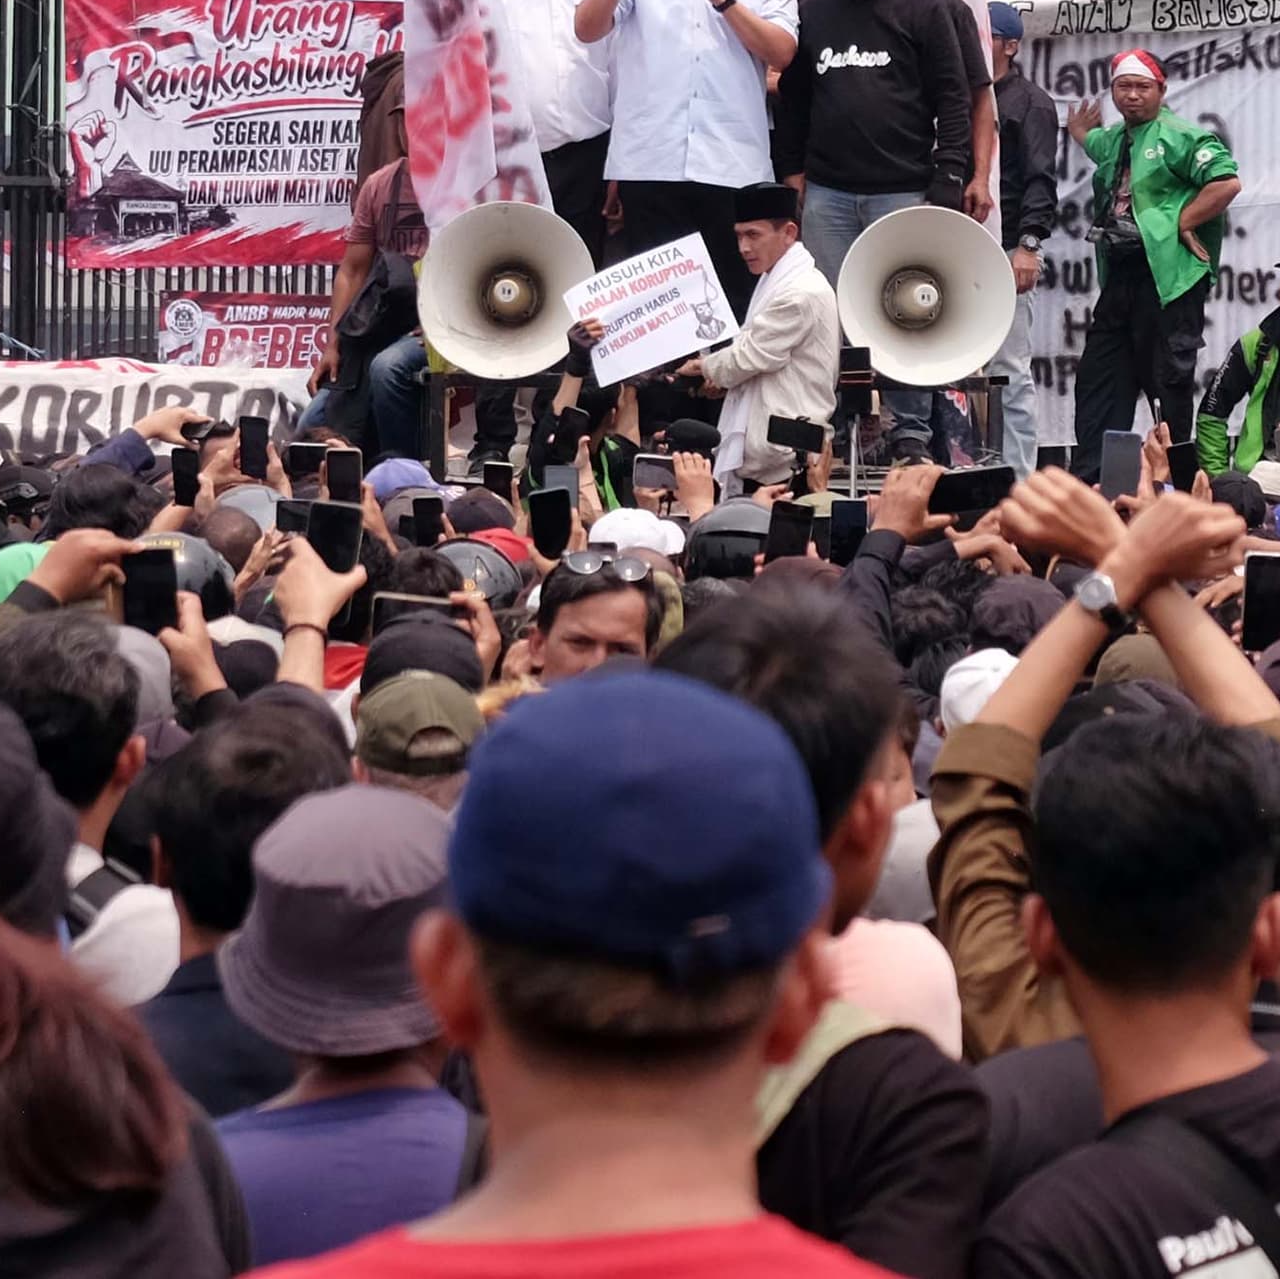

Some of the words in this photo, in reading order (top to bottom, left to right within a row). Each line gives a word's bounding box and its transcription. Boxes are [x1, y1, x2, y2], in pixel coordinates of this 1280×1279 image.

[816, 45, 892, 76] Jackson
[213, 120, 280, 146] SEGERA
[288, 120, 322, 145] SAH
[149, 150, 170, 173] UU
[177, 149, 295, 174] PERAMPASAN
[298, 149, 341, 172] ASET
[187, 179, 218, 205] DAN
[223, 179, 279, 205] HUKUM
[284, 178, 320, 204] MATI
[586, 261, 646, 296] MUSUH
[648, 246, 685, 269] KITA
[224, 304, 269, 322] AMBB
[272, 306, 306, 319] HADIR
[577, 284, 629, 318] ADALAH
[645, 287, 681, 314] HARUS
[597, 345, 611, 359] DI
[610, 324, 649, 353] HUKUM
